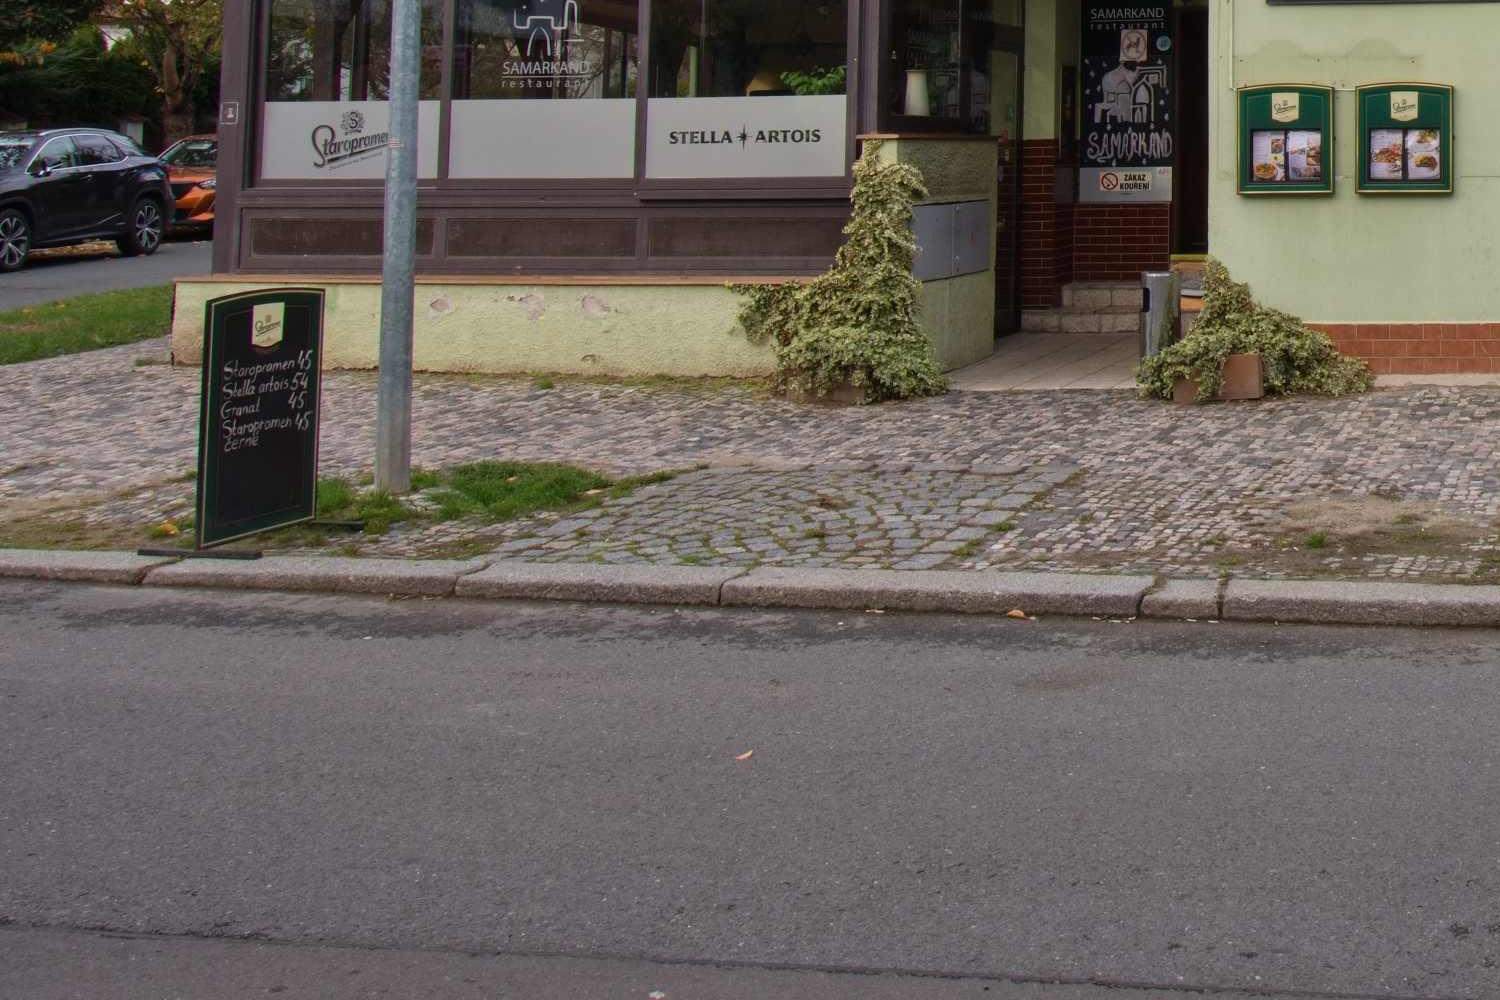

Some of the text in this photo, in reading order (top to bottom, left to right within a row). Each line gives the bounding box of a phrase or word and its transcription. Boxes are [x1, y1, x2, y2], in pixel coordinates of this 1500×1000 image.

[1090, 7, 1165, 19] SAMARKAND
[502, 61, 590, 75] SAMARKAND
[669, 129, 821, 145] STELLA ARTOIS
[1087, 130, 1173, 161] SAMARKAND
[1124, 172, 1147, 182] ZÁKAZ
[223, 350, 313, 382] Staropramen 45
[222, 372, 309, 400] Stella artois 54
[288, 391, 307, 409] 45
[222, 418, 292, 438] Staropramen
